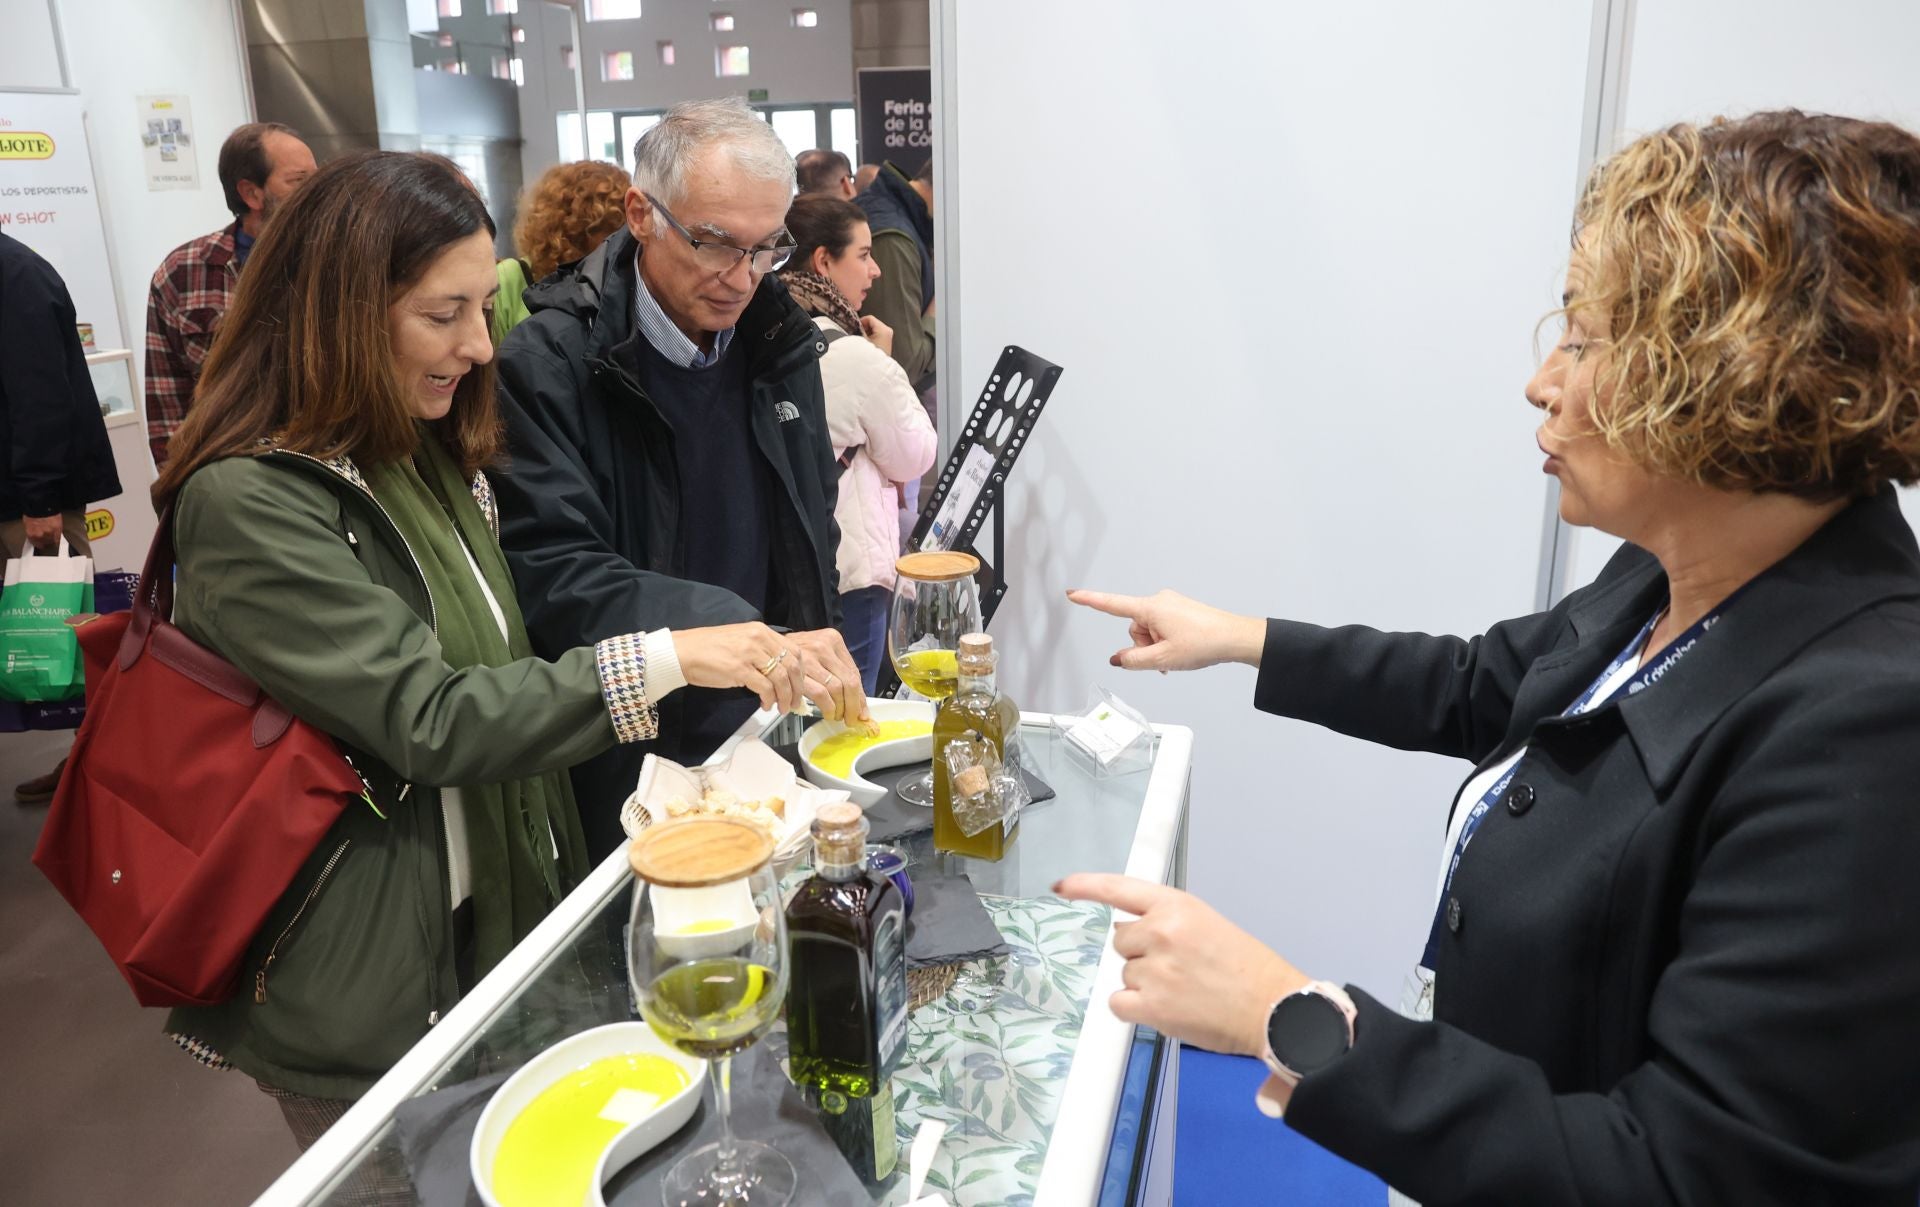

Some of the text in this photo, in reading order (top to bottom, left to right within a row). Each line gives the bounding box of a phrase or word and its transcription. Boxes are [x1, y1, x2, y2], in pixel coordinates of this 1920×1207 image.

[884, 99, 924, 115] Feria
[884, 117, 905, 131] de
[910, 116, 923, 131] la
[884, 132, 905, 147] de
[24, 186, 88, 196] DEPORTISTAS
[16, 211, 56, 224] SHOT
